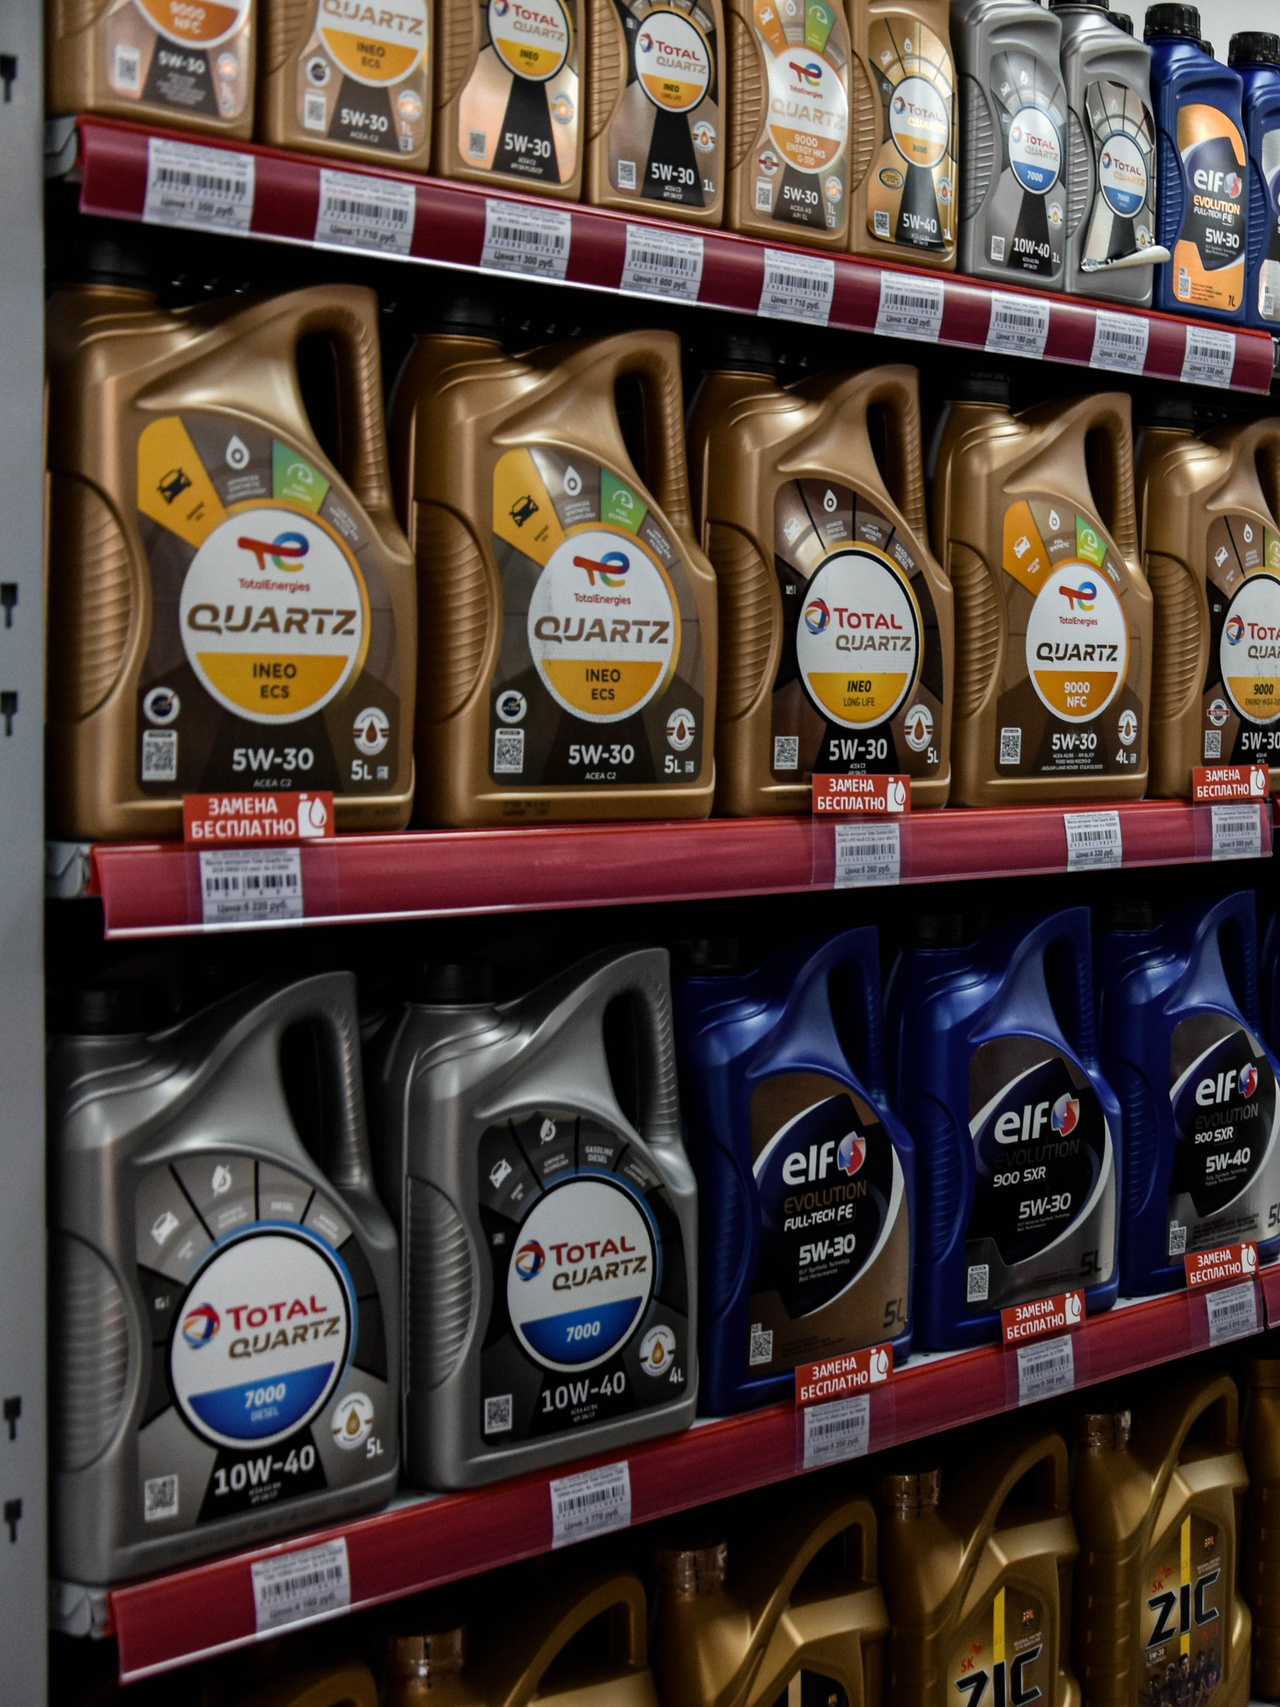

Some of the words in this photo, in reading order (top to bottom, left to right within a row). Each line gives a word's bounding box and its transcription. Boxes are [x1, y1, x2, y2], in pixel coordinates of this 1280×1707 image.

[512, 4, 558, 27] TOTAL
[356, 41, 386, 59] INEO
[656, 40, 700, 62] TOTAL
[341, 108, 388, 133] 5W-30
[908, 102, 942, 122] TOTAL
[504, 132, 550, 158] 5W-30
[1024, 132, 1054, 150] TOTAL
[652, 163, 694, 185] 5W-30
[1114, 158, 1141, 176] TOTAL
[1194, 170, 1223, 193] elf
[784, 185, 818, 205] 5W-30
[1194, 196, 1240, 214] EVOLUTION
[903, 213, 937, 233] 5W-40
[1014, 237, 1050, 258] 10W-40
[1205, 228, 1240, 248] 5W-30
[238, 578, 310, 593] TotalEnergies
[574, 592, 631, 606] TotalEnergies
[187, 604, 357, 635] QUARTZ
[833, 608, 902, 630] TOTAL
[534, 616, 670, 644] QUARTZ
[836, 634, 911, 652] QUARTZ
[1036, 642, 1118, 662] QUARTZ
[253, 664, 296, 679] INEO
[586, 668, 621, 682] INEO
[260, 685, 290, 699] ECS
[592, 689, 615, 700] ECS
[847, 680, 872, 692] INEO
[1064, 682, 1090, 694] 9000
[1254, 683, 1274, 694] 9000
[1067, 696, 1086, 708] NFC
[829, 739, 888, 760] 5W-30
[1052, 734, 1096, 750] 5W-30
[232, 748, 314, 771] 5W-30
[569, 745, 634, 764] 5W-30
[352, 760, 372, 780] 5L
[664, 756, 681, 774] 5L
[254, 779, 276, 788] ACEA
[278, 779, 291, 788] C2
[586, 772, 606, 780] ACEA
[606, 772, 616, 780] C2
[829, 779, 874, 792] ЗАМЕНА
[1206, 769, 1240, 782] ЗАМЕНА
[1197, 784, 1249, 797] БЕСПЛАТНО
[209, 798, 278, 815] ЗАМЕНА
[818, 797, 886, 811] БЕСПЛАТНО
[191, 819, 296, 838] БЕСПЛАТНО
[1196, 1070, 1236, 1106] elf
[994, 1102, 1050, 1144] elf
[585, 1146, 613, 1156] GASOLINE
[1206, 1148, 1250, 1173] 5W-40
[782, 1140, 835, 1186] elf
[993, 1171, 1020, 1187] 900
[1023, 1166, 1046, 1183] SXR
[784, 1179, 867, 1215] EVOLUTION
[1018, 1193, 1071, 1220] 5W-30
[784, 1209, 835, 1232] FULL-TECH
[838, 1204, 853, 1220] FE
[550, 1236, 635, 1266] TOTAL
[799, 1234, 856, 1266] 5W-30
[1198, 1250, 1232, 1268] ЗАМЕНА
[552, 1255, 647, 1291] QUARTZ
[1190, 1262, 1240, 1284] БЕСПЛАТНО
[226, 1295, 327, 1332] TOTAL
[1016, 1301, 1054, 1320] ЗАМЕНА
[566, 1321, 600, 1342] 7000
[1007, 1314, 1065, 1340] БЕСПЛАТНО
[228, 1316, 341, 1359] QUARTZ
[812, 1358, 856, 1378] ЗАМЕНА
[245, 1383, 286, 1408] 7000
[542, 1372, 626, 1413] 10W-40
[801, 1372, 868, 1400] БЕСПЛАТНО
[214, 1444, 316, 1496] 10W-40
[1152, 1579, 1164, 1593] SK
[1147, 1568, 1220, 1649] ZIC
[960, 1657, 974, 1672] SK
